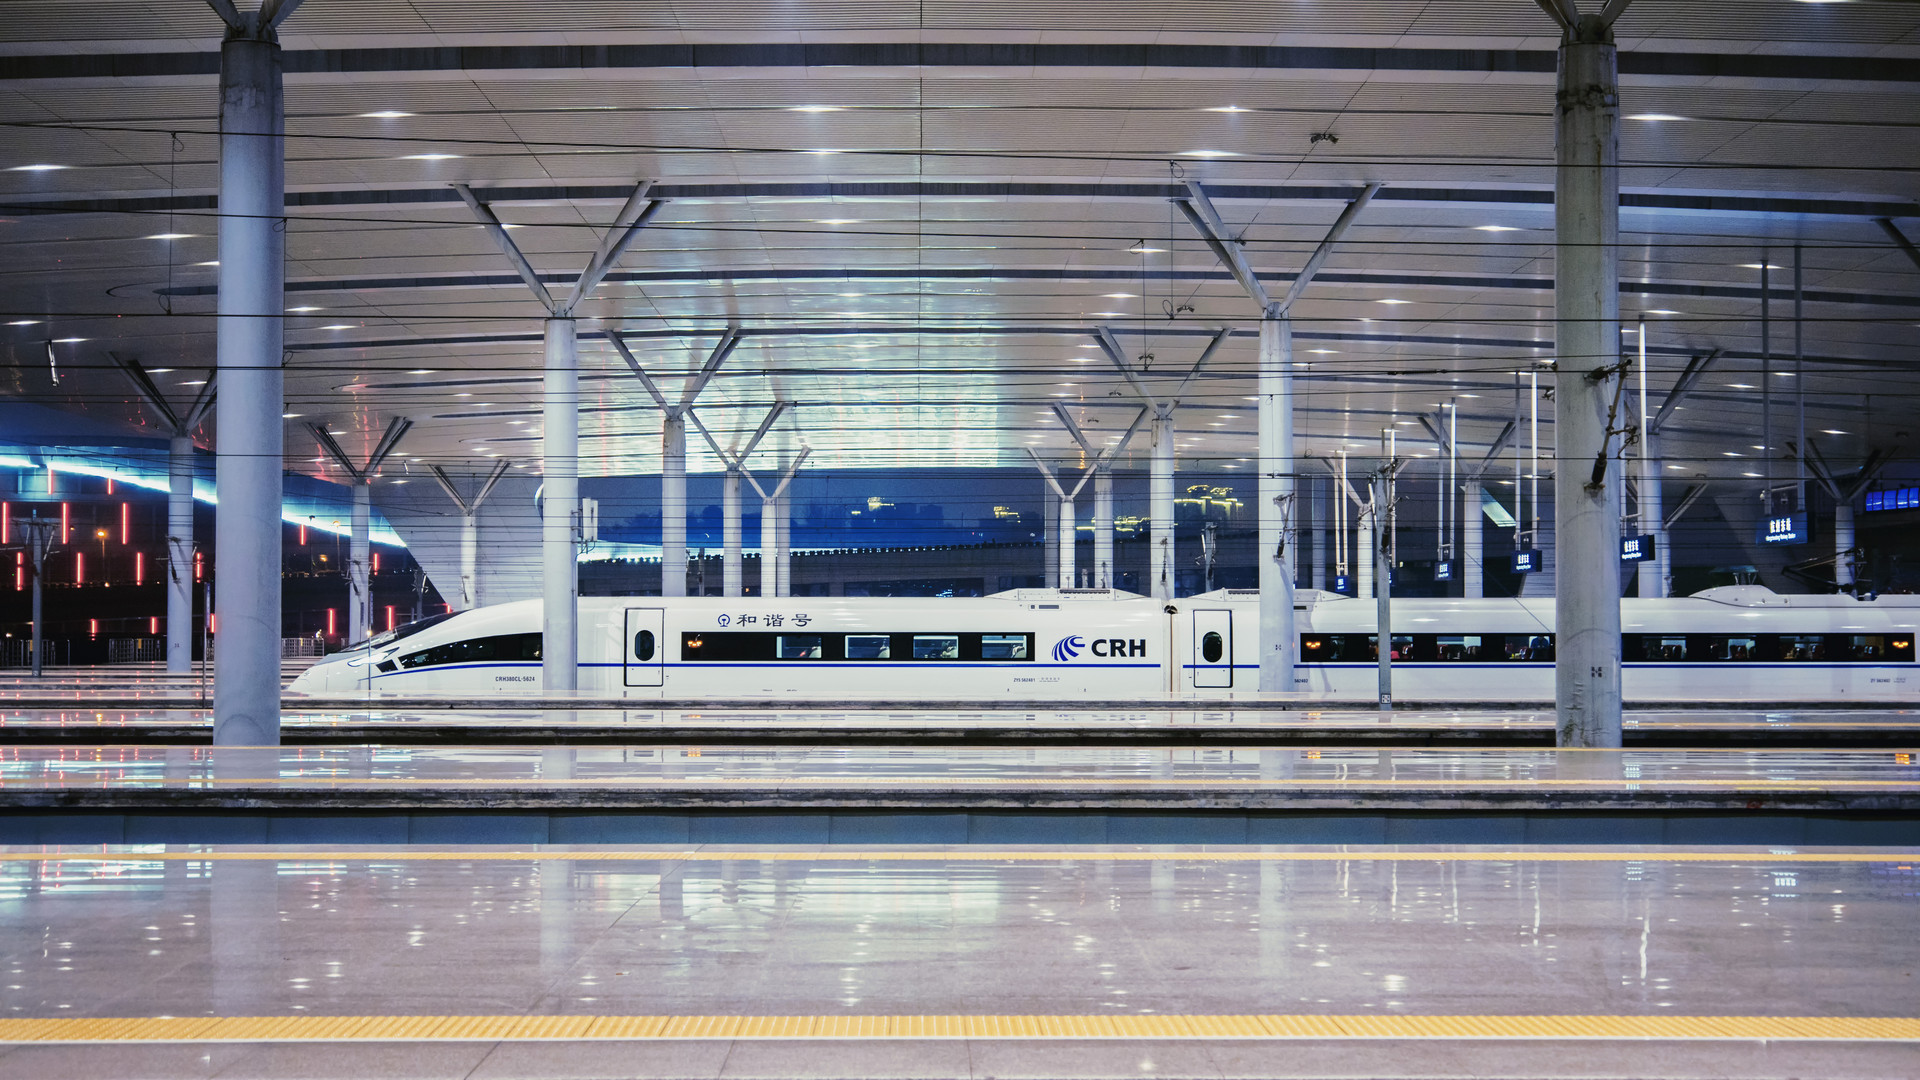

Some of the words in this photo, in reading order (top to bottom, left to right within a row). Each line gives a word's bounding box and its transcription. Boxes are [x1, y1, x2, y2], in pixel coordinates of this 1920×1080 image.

[736, 613, 813, 627] 和谐号
[1091, 638, 1146, 657] CRH
